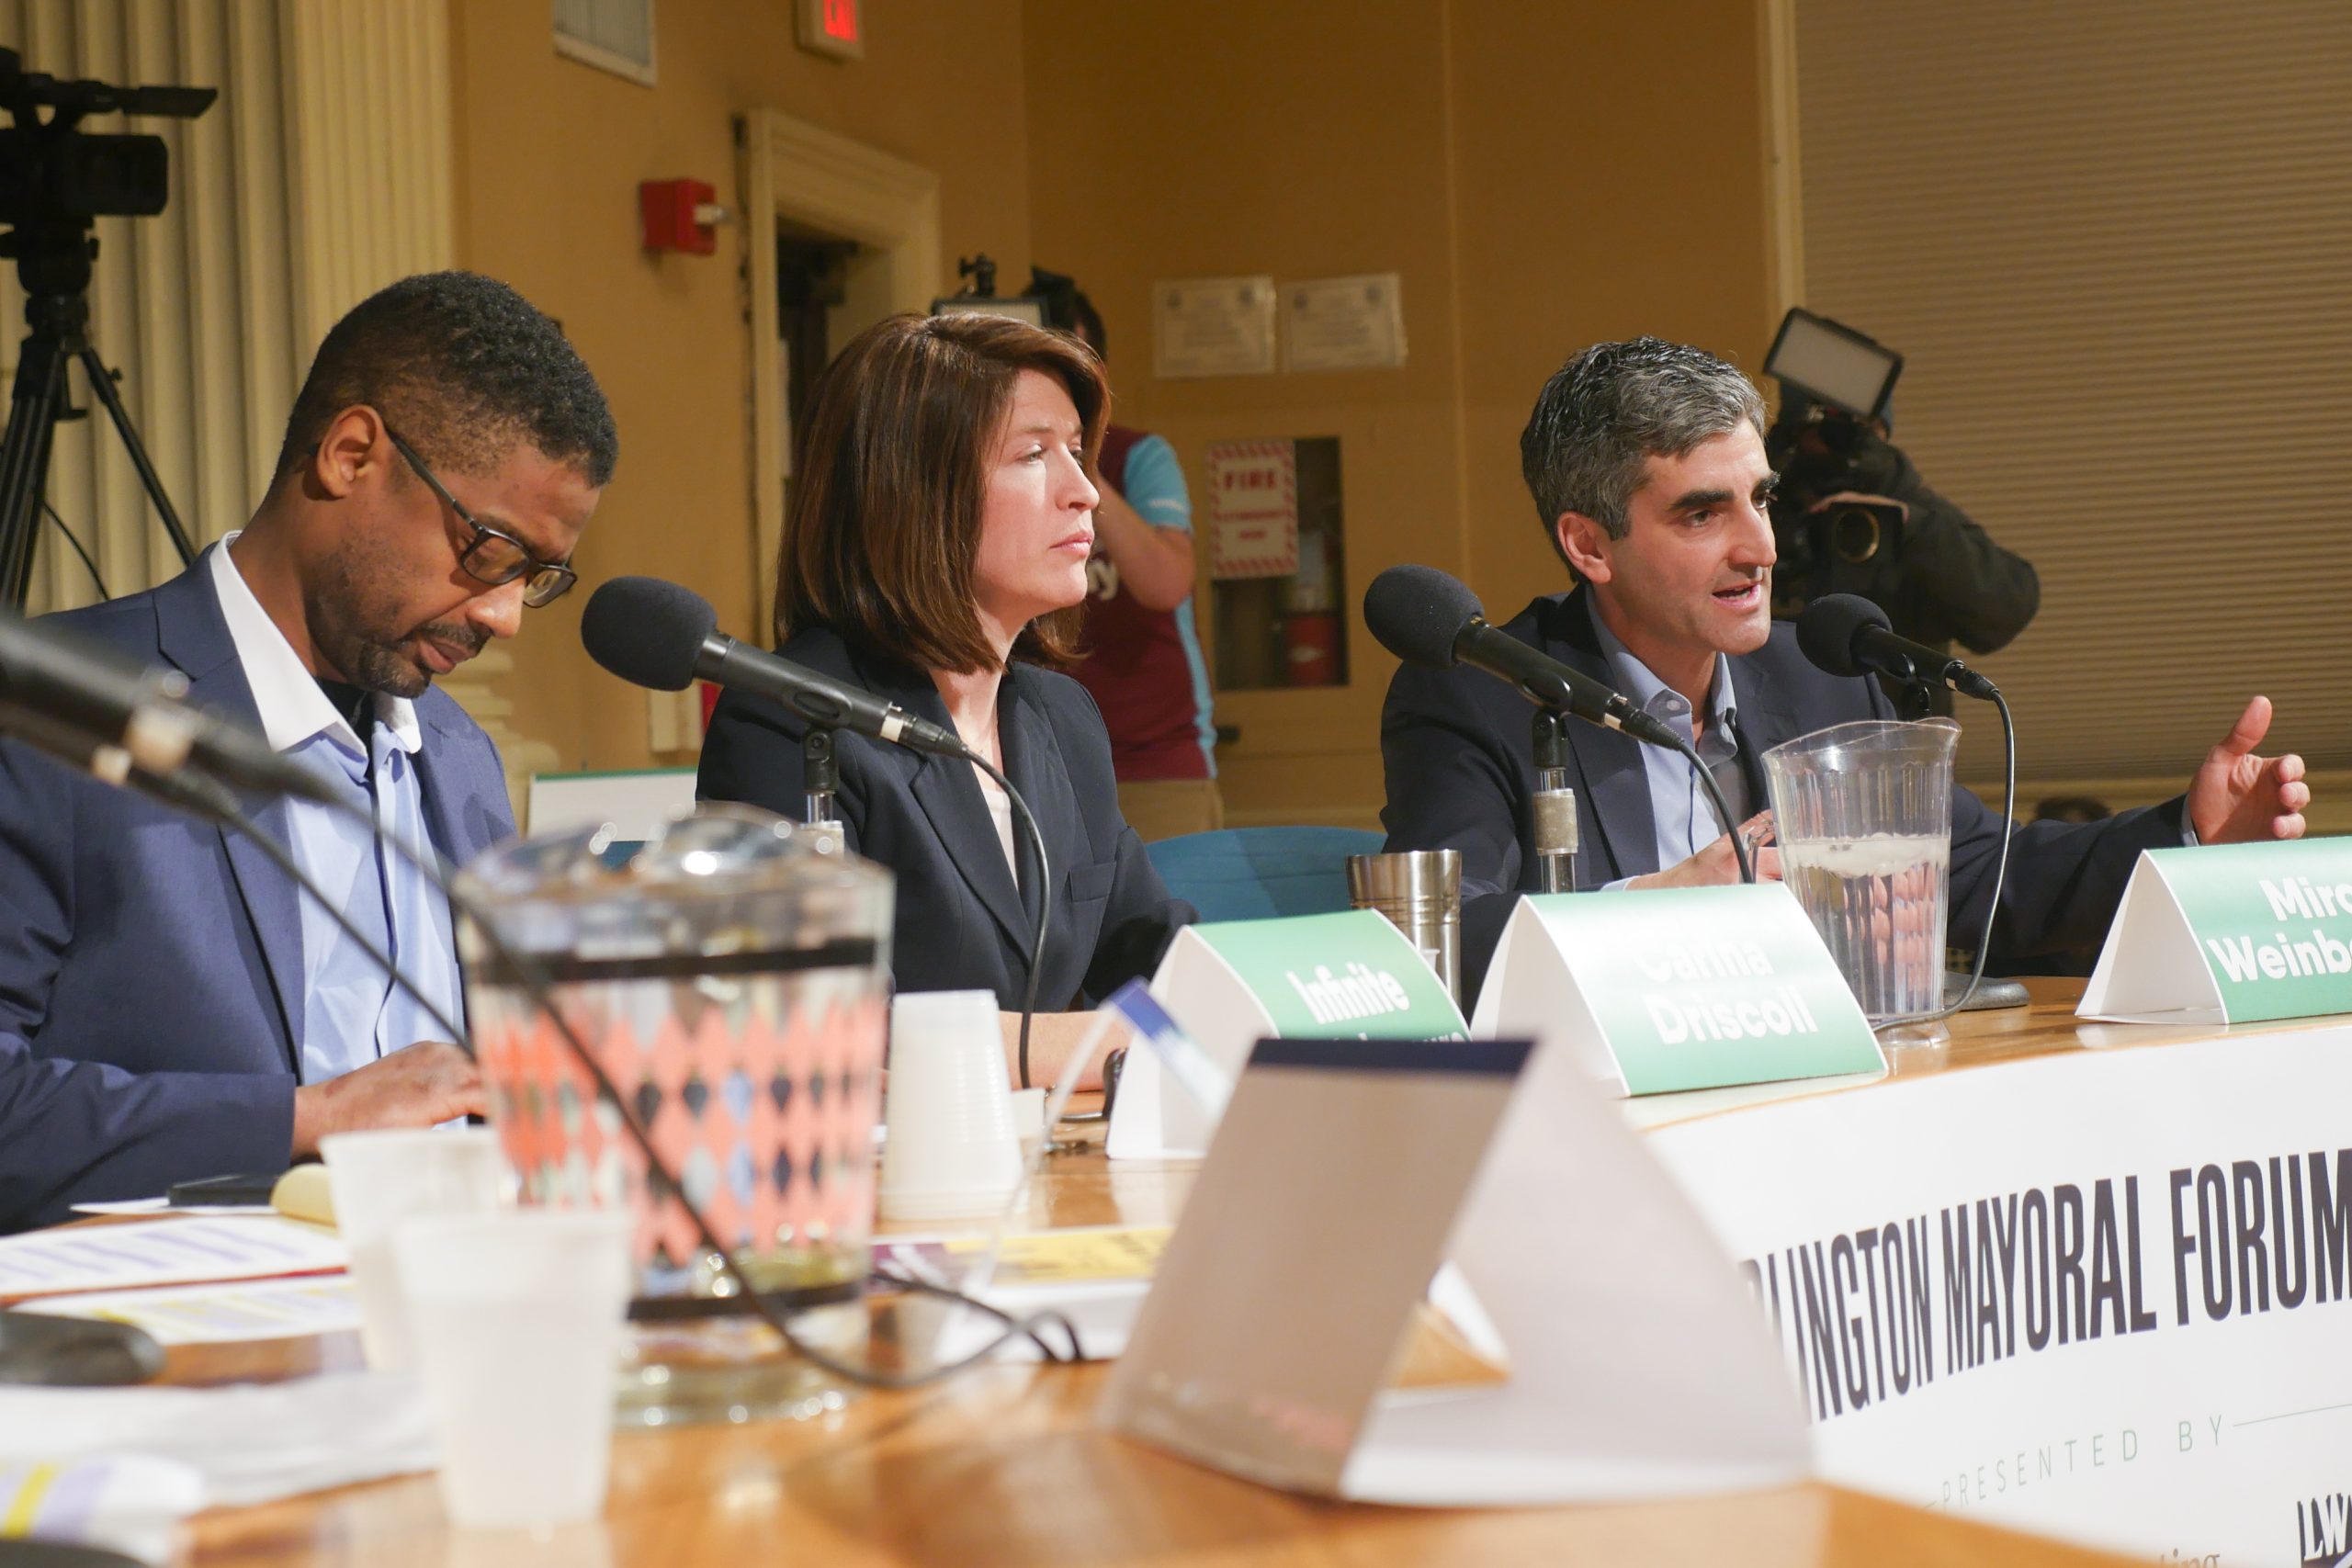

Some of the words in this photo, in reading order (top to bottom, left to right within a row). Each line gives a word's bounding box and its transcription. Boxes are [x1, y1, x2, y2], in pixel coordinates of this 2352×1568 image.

[2206, 929, 2352, 983] Weinb
[1285, 962, 1410, 1025] Infinite
[1642, 983, 1819, 1044] Driscoll
[1940, 1174, 2157, 1376] MAYORAL
[2169, 1147, 2352, 1327] FORUM
[1942, 1428, 2138, 1513] PRESENTED
[2177, 1414, 2222, 1452] BY
[2299, 1491, 2352, 1562] LW
